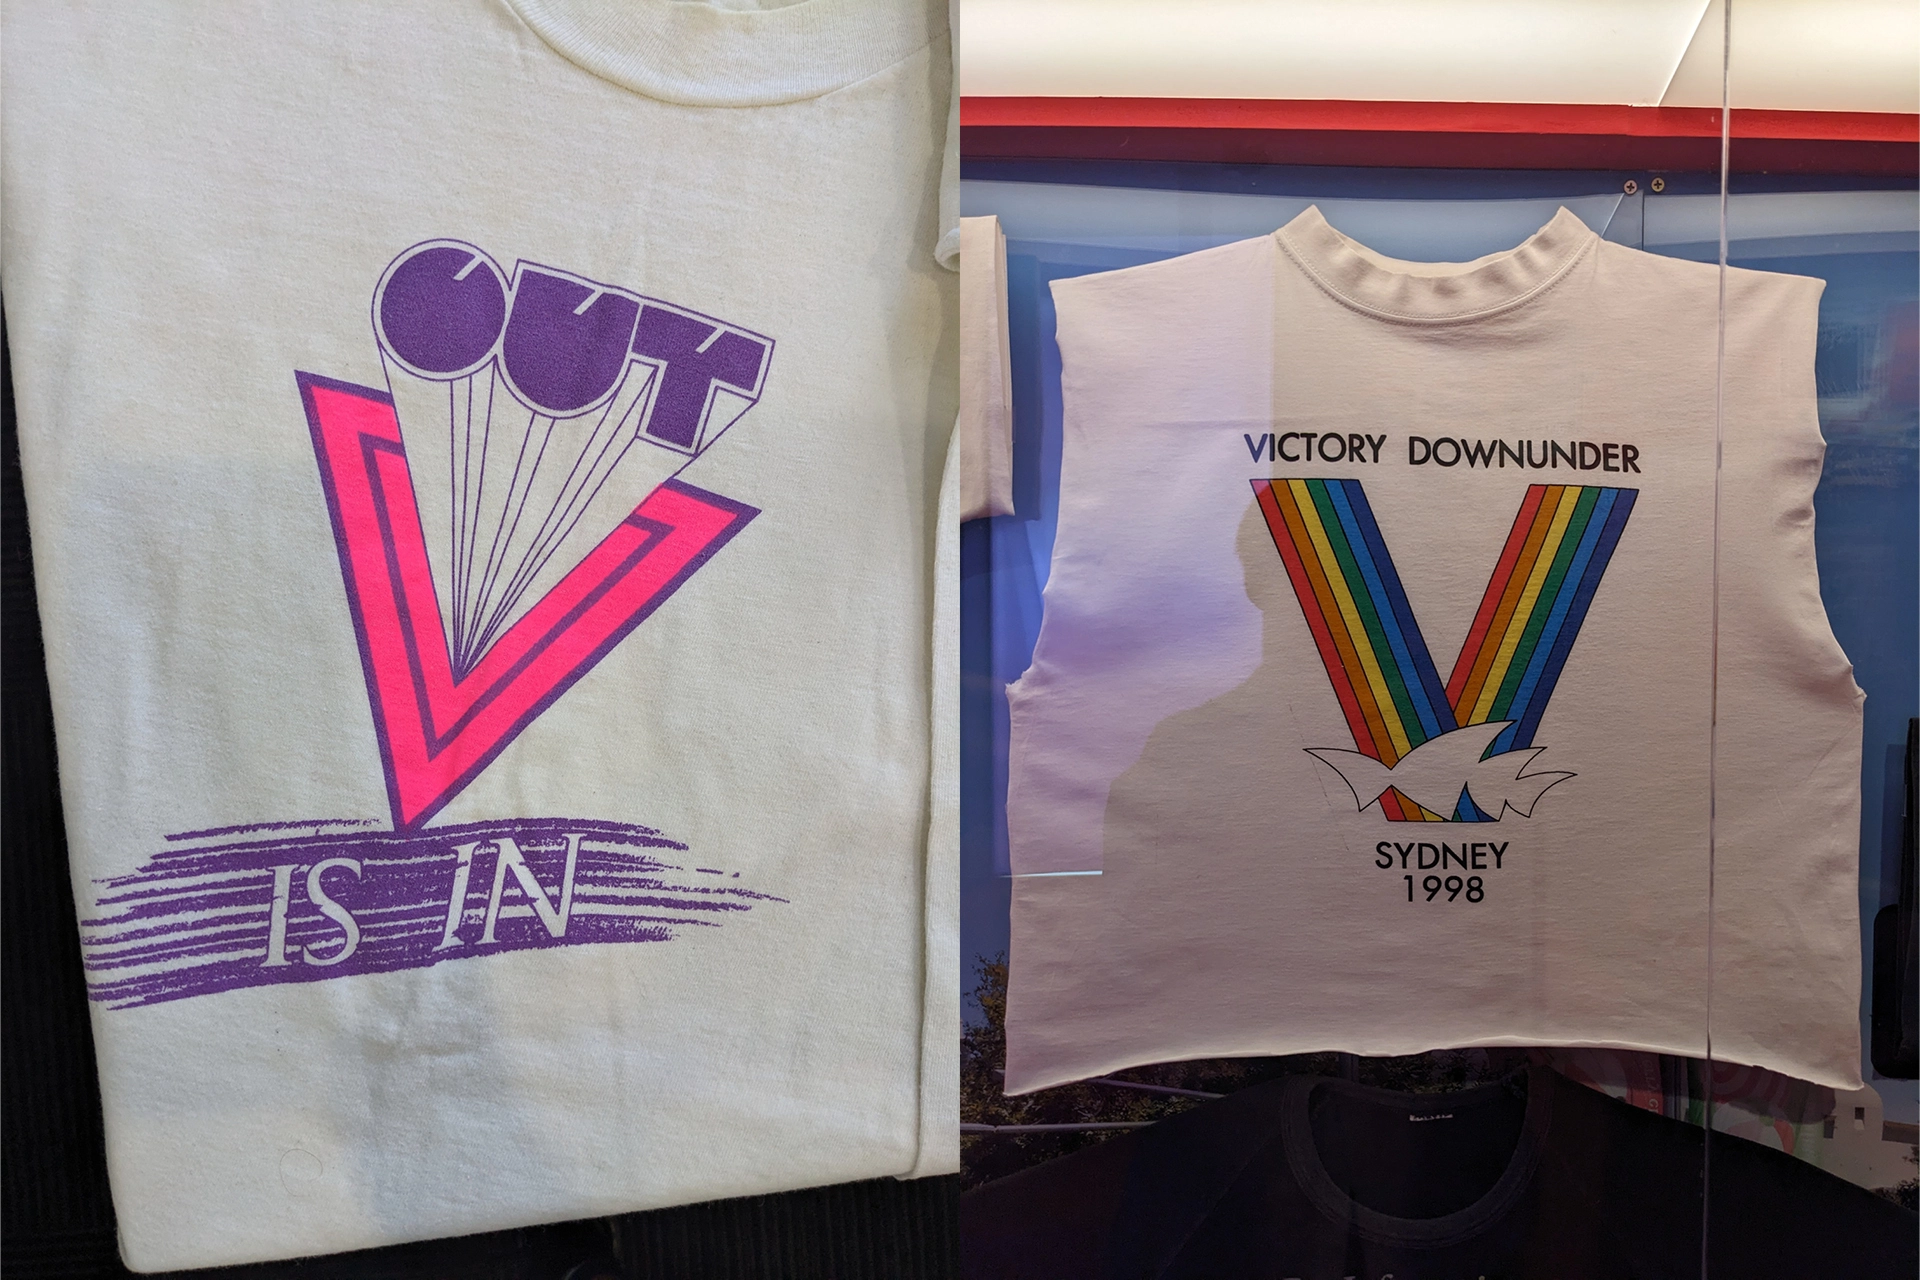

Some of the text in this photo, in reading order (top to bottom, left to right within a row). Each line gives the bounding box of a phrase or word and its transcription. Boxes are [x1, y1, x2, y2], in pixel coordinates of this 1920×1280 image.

[372, 239, 775, 458] OUT
[1243, 432, 1641, 474] VICTORY DOWNUNDER
[1375, 841, 1509, 870] SYDNEY
[259, 833, 587, 967] IS IN
[1403, 875, 1485, 903] 1998
